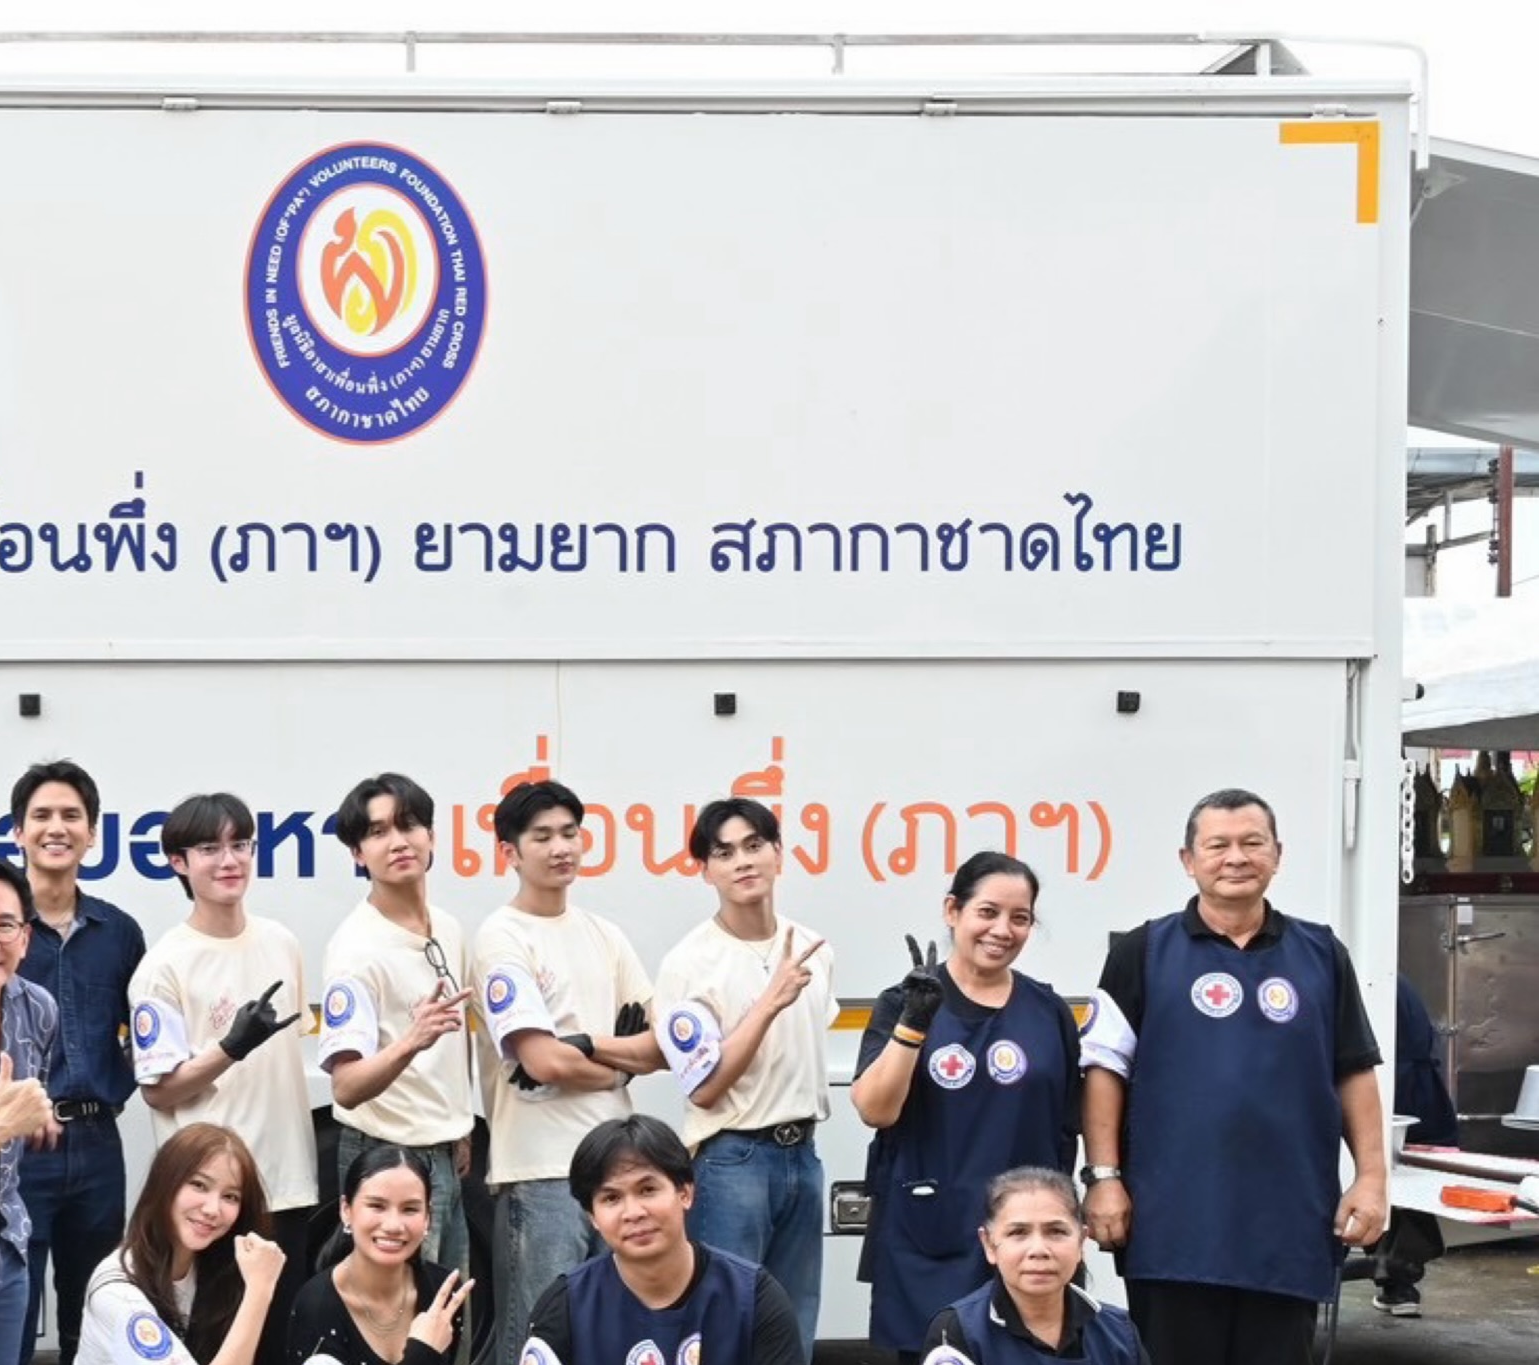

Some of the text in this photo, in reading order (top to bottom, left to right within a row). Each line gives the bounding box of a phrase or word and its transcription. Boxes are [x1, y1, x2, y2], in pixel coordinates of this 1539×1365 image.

[309, 156, 397, 188] VOLUNTEERS
[399, 168, 458, 246] FOUNDATION
[265, 244, 283, 284] NEED
[450, 248, 467, 282] THAI
[265, 288, 278, 304] IN
[454, 286, 468, 316] RED
[265, 308, 291, 370] FRIENDS
[442, 321, 465, 370] CROSS
[305, 385, 431, 429] สภากาชาดไทย
[210, 522, 383, 583] (ภาฯ)
[415, 521, 676, 573] ยามยาก
[709, 492, 1183, 573] สภากาชาดไทย
[862, 801, 1113, 882] (ภาฯ)
